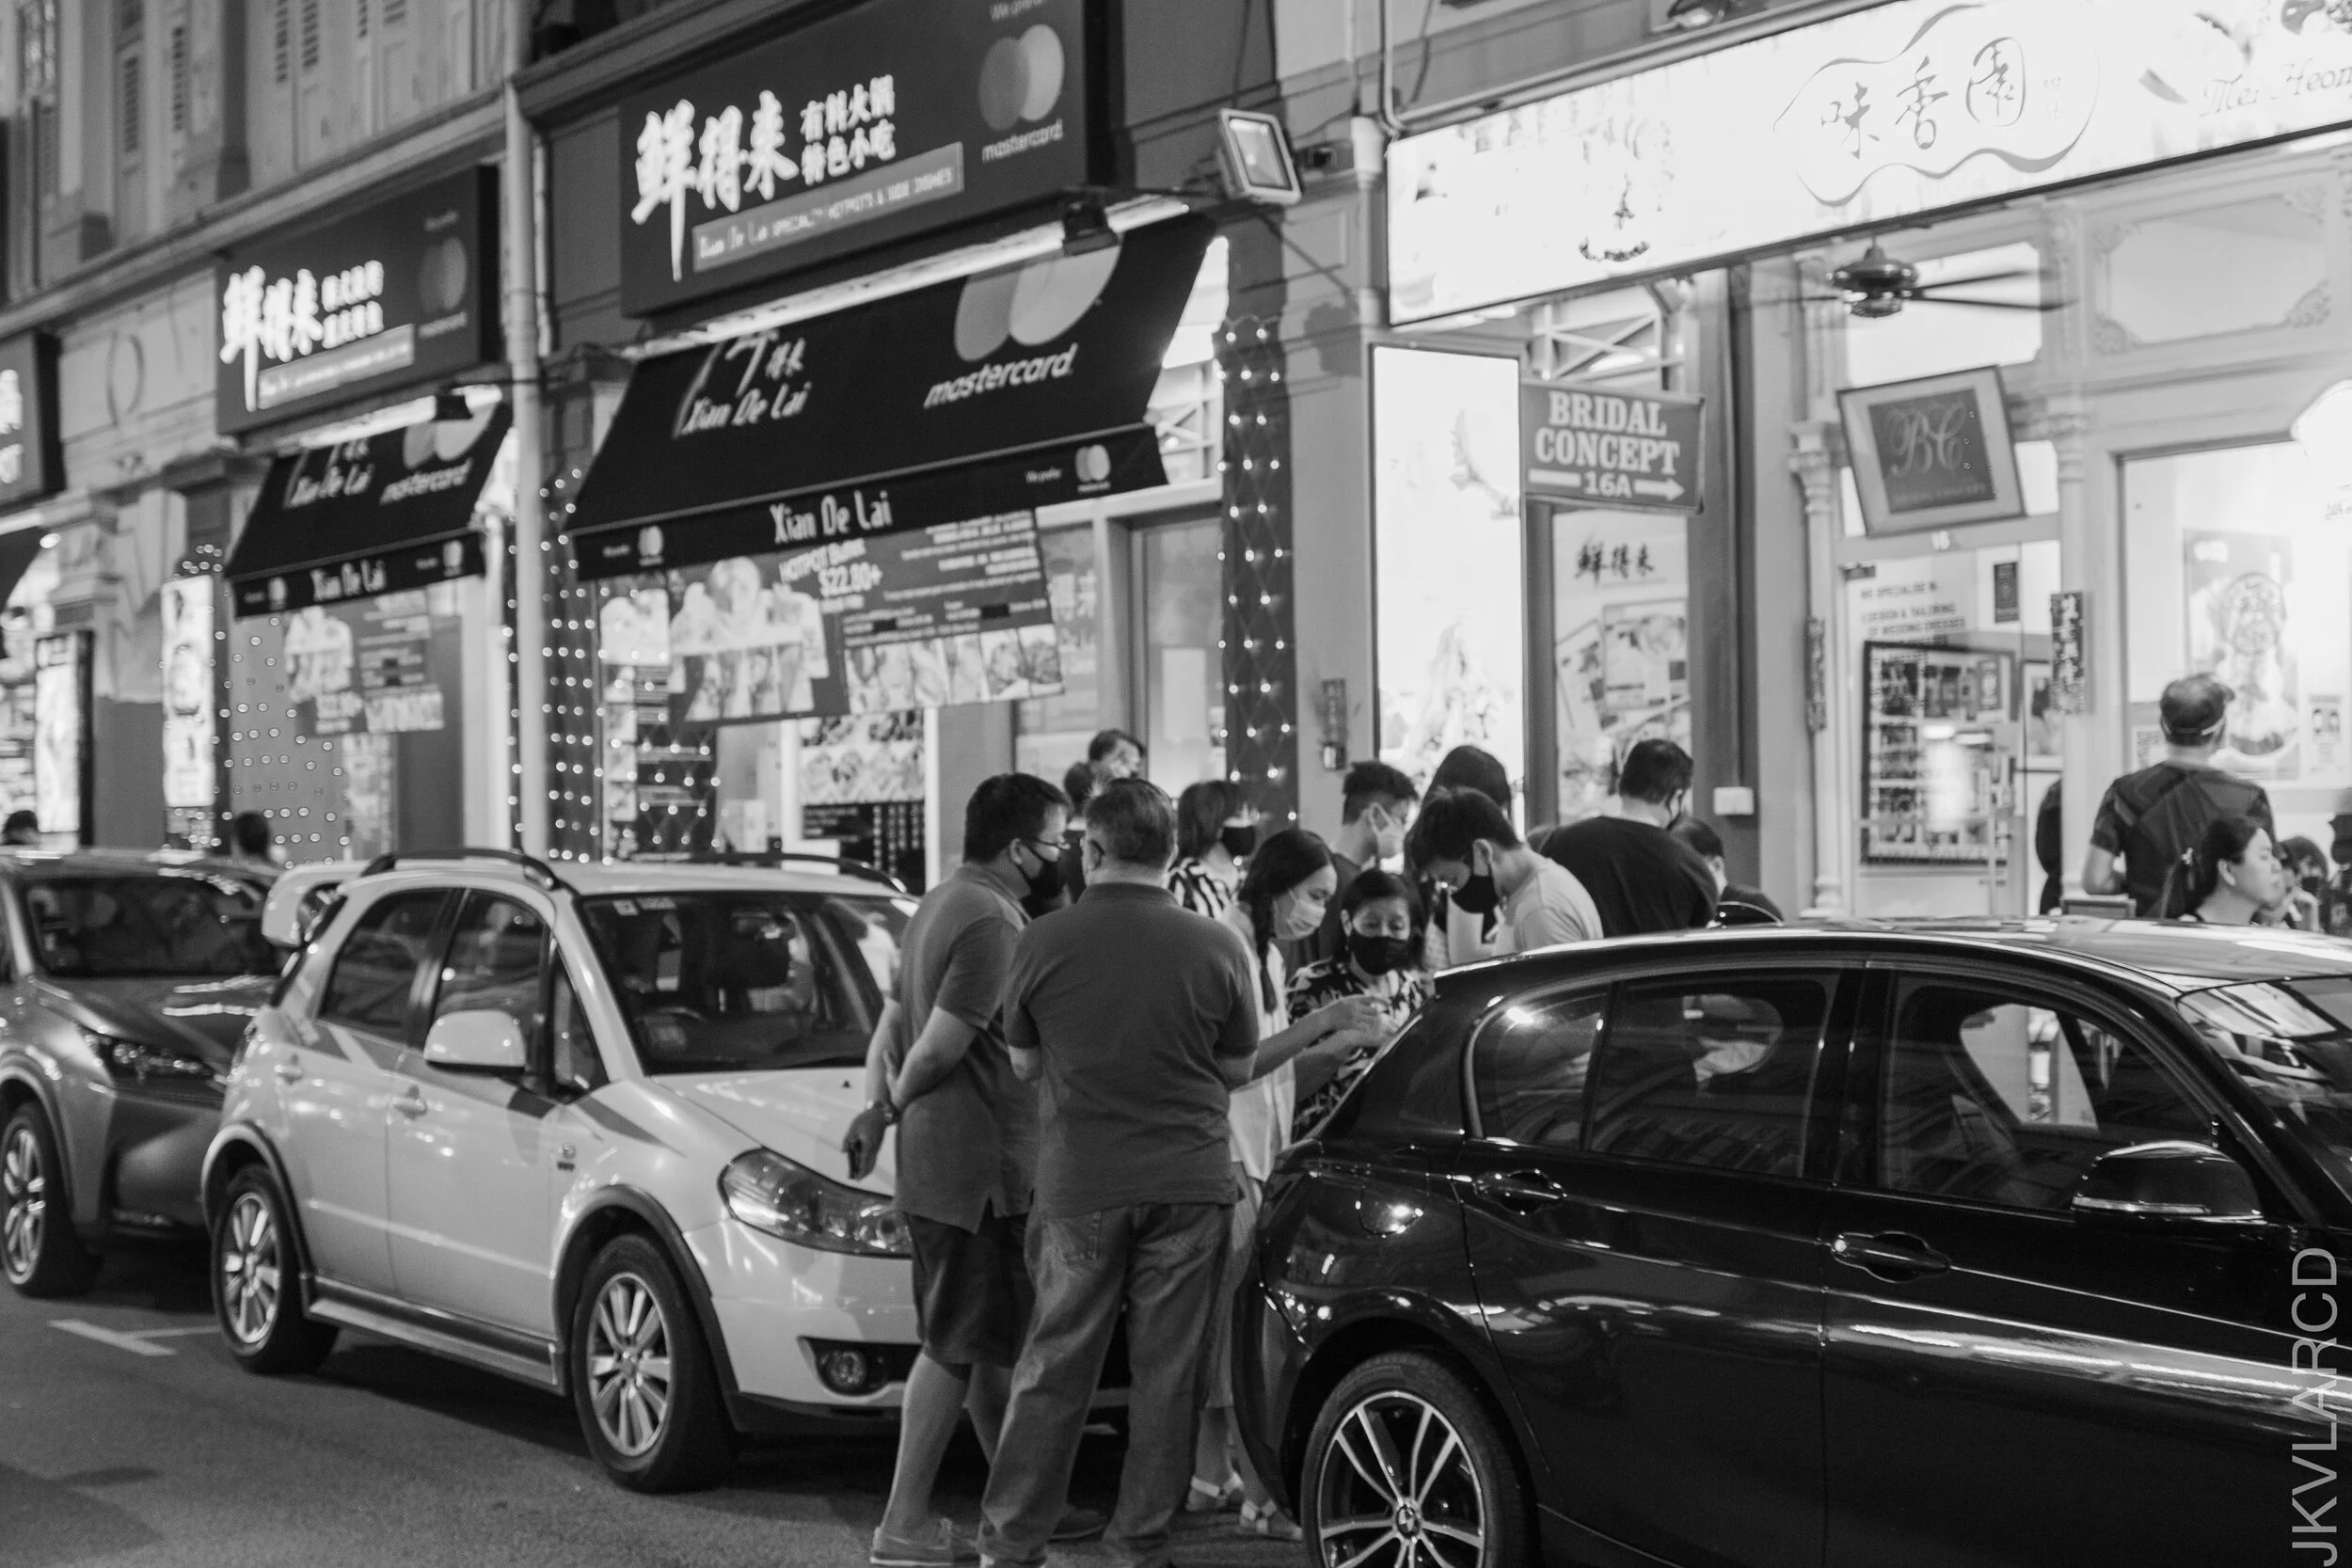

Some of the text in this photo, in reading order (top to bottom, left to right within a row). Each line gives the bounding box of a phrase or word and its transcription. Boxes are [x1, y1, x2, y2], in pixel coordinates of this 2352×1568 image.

[981, 117, 1064, 164] mastercard
[922, 341, 1079, 410] mastercard
[1548, 390, 1668, 437] BRIDAL
[1534, 426, 1681, 476] CONCEPT
[1583, 470, 1633, 499] 16A
[769, 502, 818, 545] Xian
[820, 494, 850, 536] De
[853, 489, 893, 531] Lai
